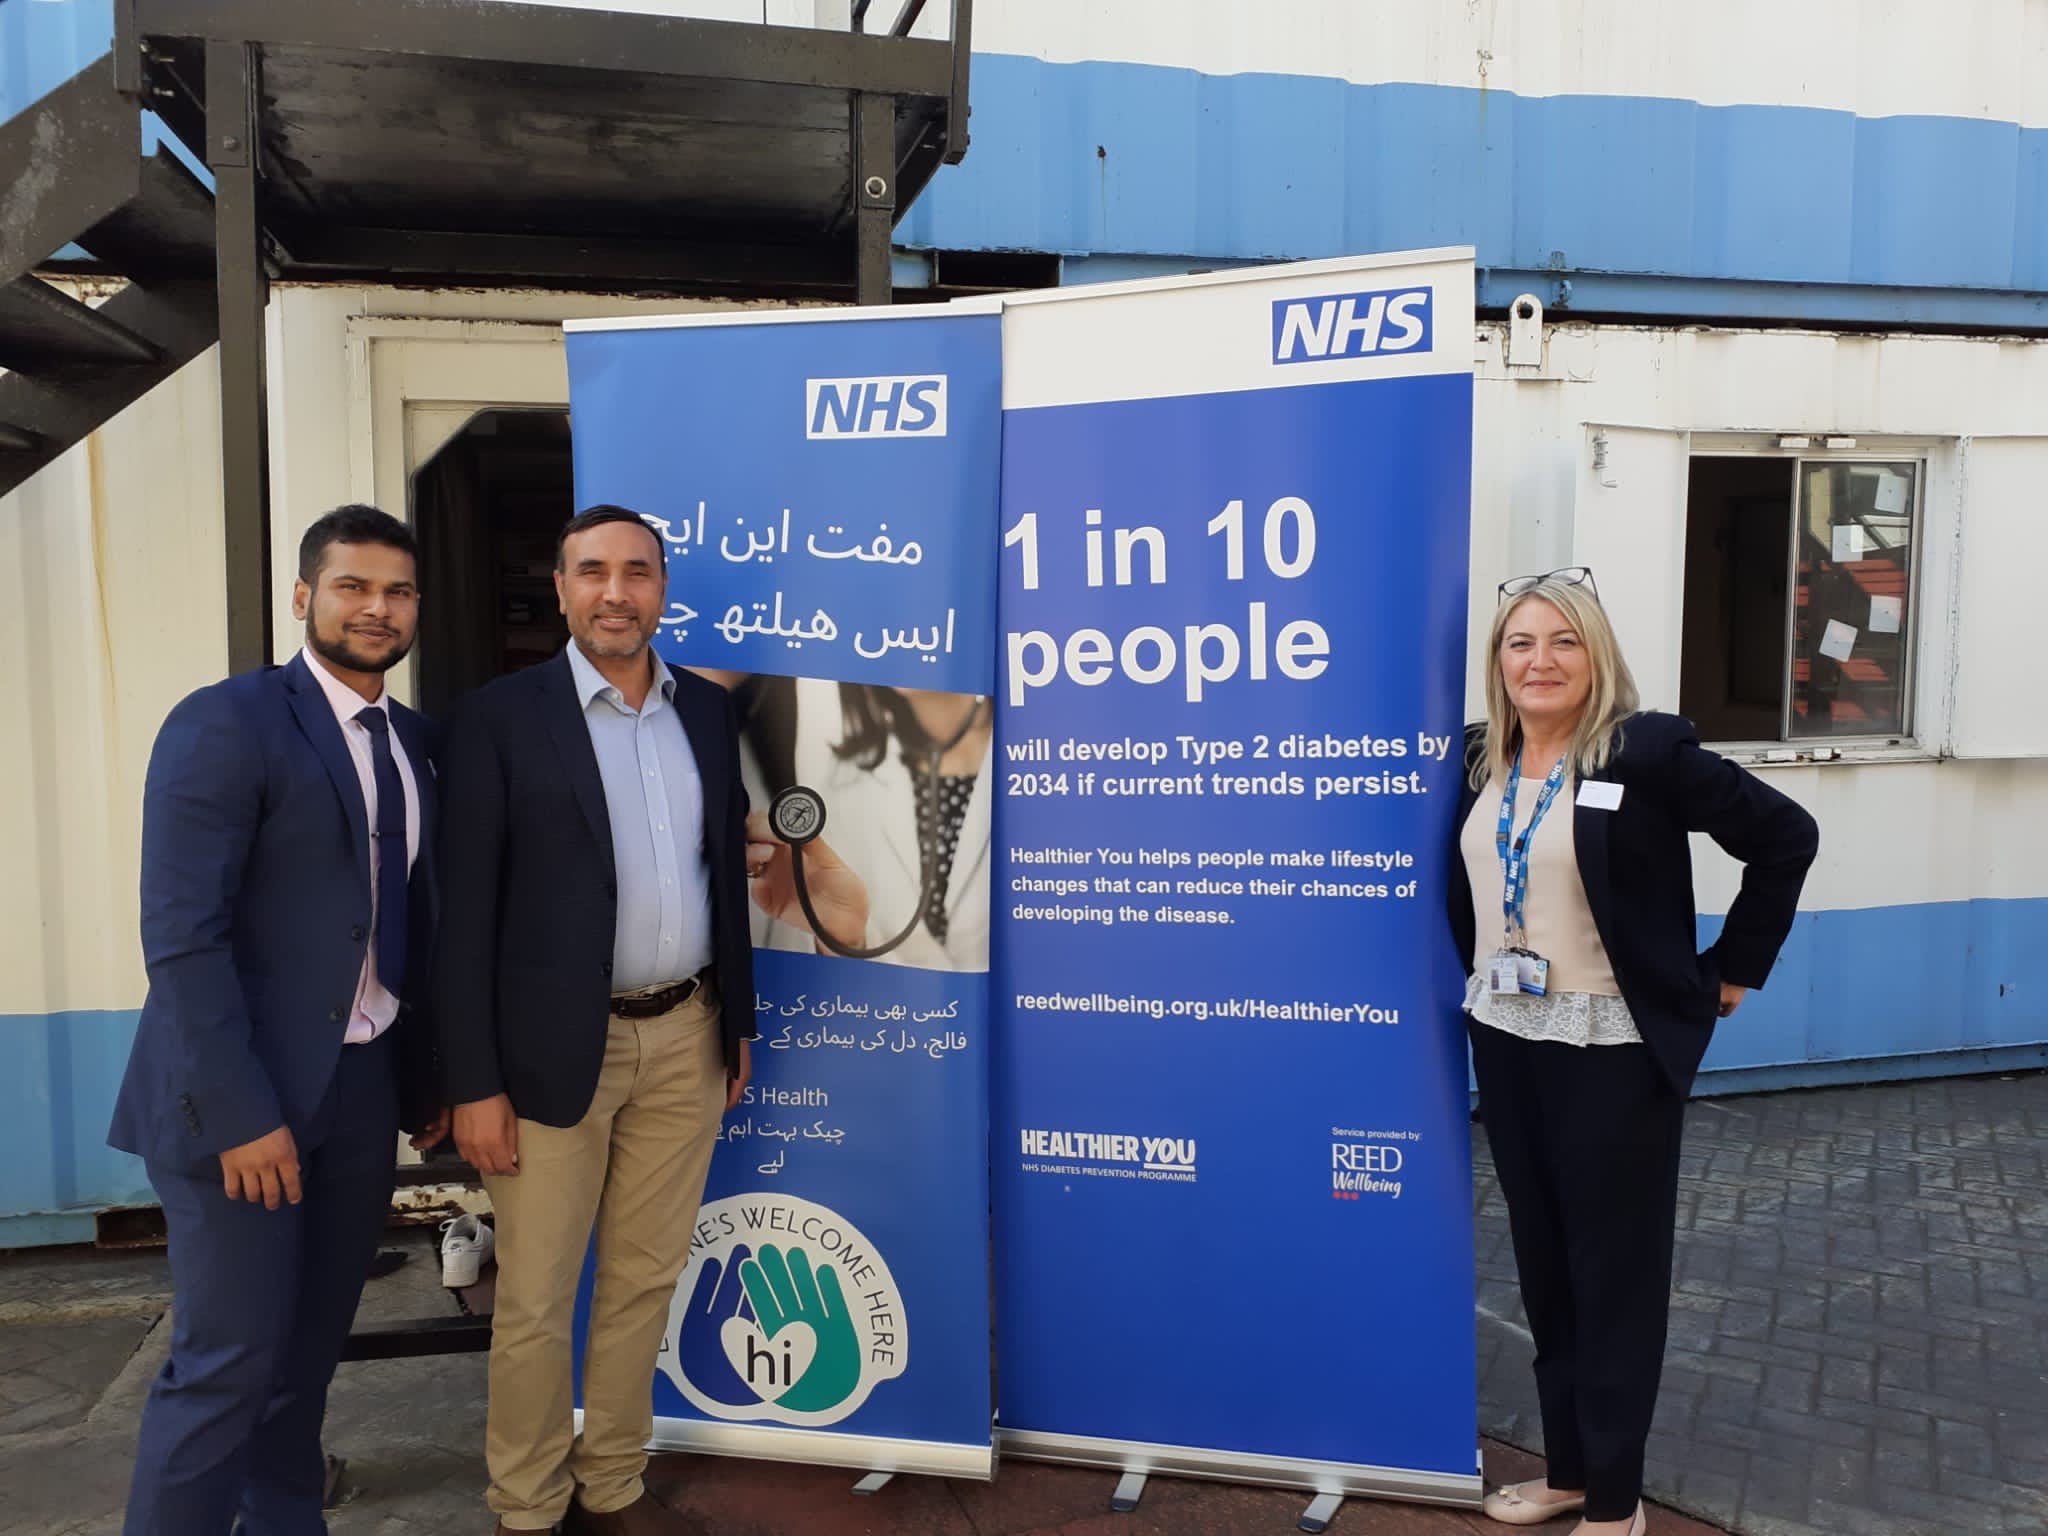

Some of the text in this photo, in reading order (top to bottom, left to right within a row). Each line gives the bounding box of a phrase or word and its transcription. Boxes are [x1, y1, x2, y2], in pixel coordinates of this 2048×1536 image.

[1278, 292, 1428, 360] NHS
[811, 380, 940, 434] NHS
[720, 509, 790, 563] این
[807, 523, 922, 565] مفت
[1004, 497, 1316, 590] 1 in 10
[854, 608, 955, 663] ایس
[1007, 601, 1331, 707] people
[1007, 730, 1451, 765] will develop Type 2 diabetes by
[1007, 770, 1428, 800] 2034 if current trends persist.
[1010, 846, 1414, 872] Healthier You helps people make lifestyle
[1011, 876, 1417, 898] changes that can reduce their chances of
[1012, 904, 1235, 925] developing the disease.
[780, 994, 808, 1016] کی
[811, 995, 868, 1018] بیماری
[912, 1000, 958, 1022] کسی
[1016, 992, 1399, 1024] reedwellbeing.org.uk/HealthierYou
[769, 1025, 792, 1049] کے
[797, 1026, 854, 1048] بیماری
[861, 1029, 886, 1050] کی
[891, 1030, 916, 1052] دل
[762, 1088, 828, 1106] Health
[803, 1120, 845, 1144] چیک
[1021, 1129, 1196, 1164] HEALTHIER YOU
[1331, 1126, 1420, 1141] Service provided by
[1022, 1162, 1197, 1183] NHS DIABETES PREVENTION PROGRAMME
[1331, 1143, 1403, 1173] REED
[1332, 1170, 1402, 1199] Wellbeing
[741, 1206, 895, 1366] WELCOME HERE
[747, 1334, 791, 1386] hi
